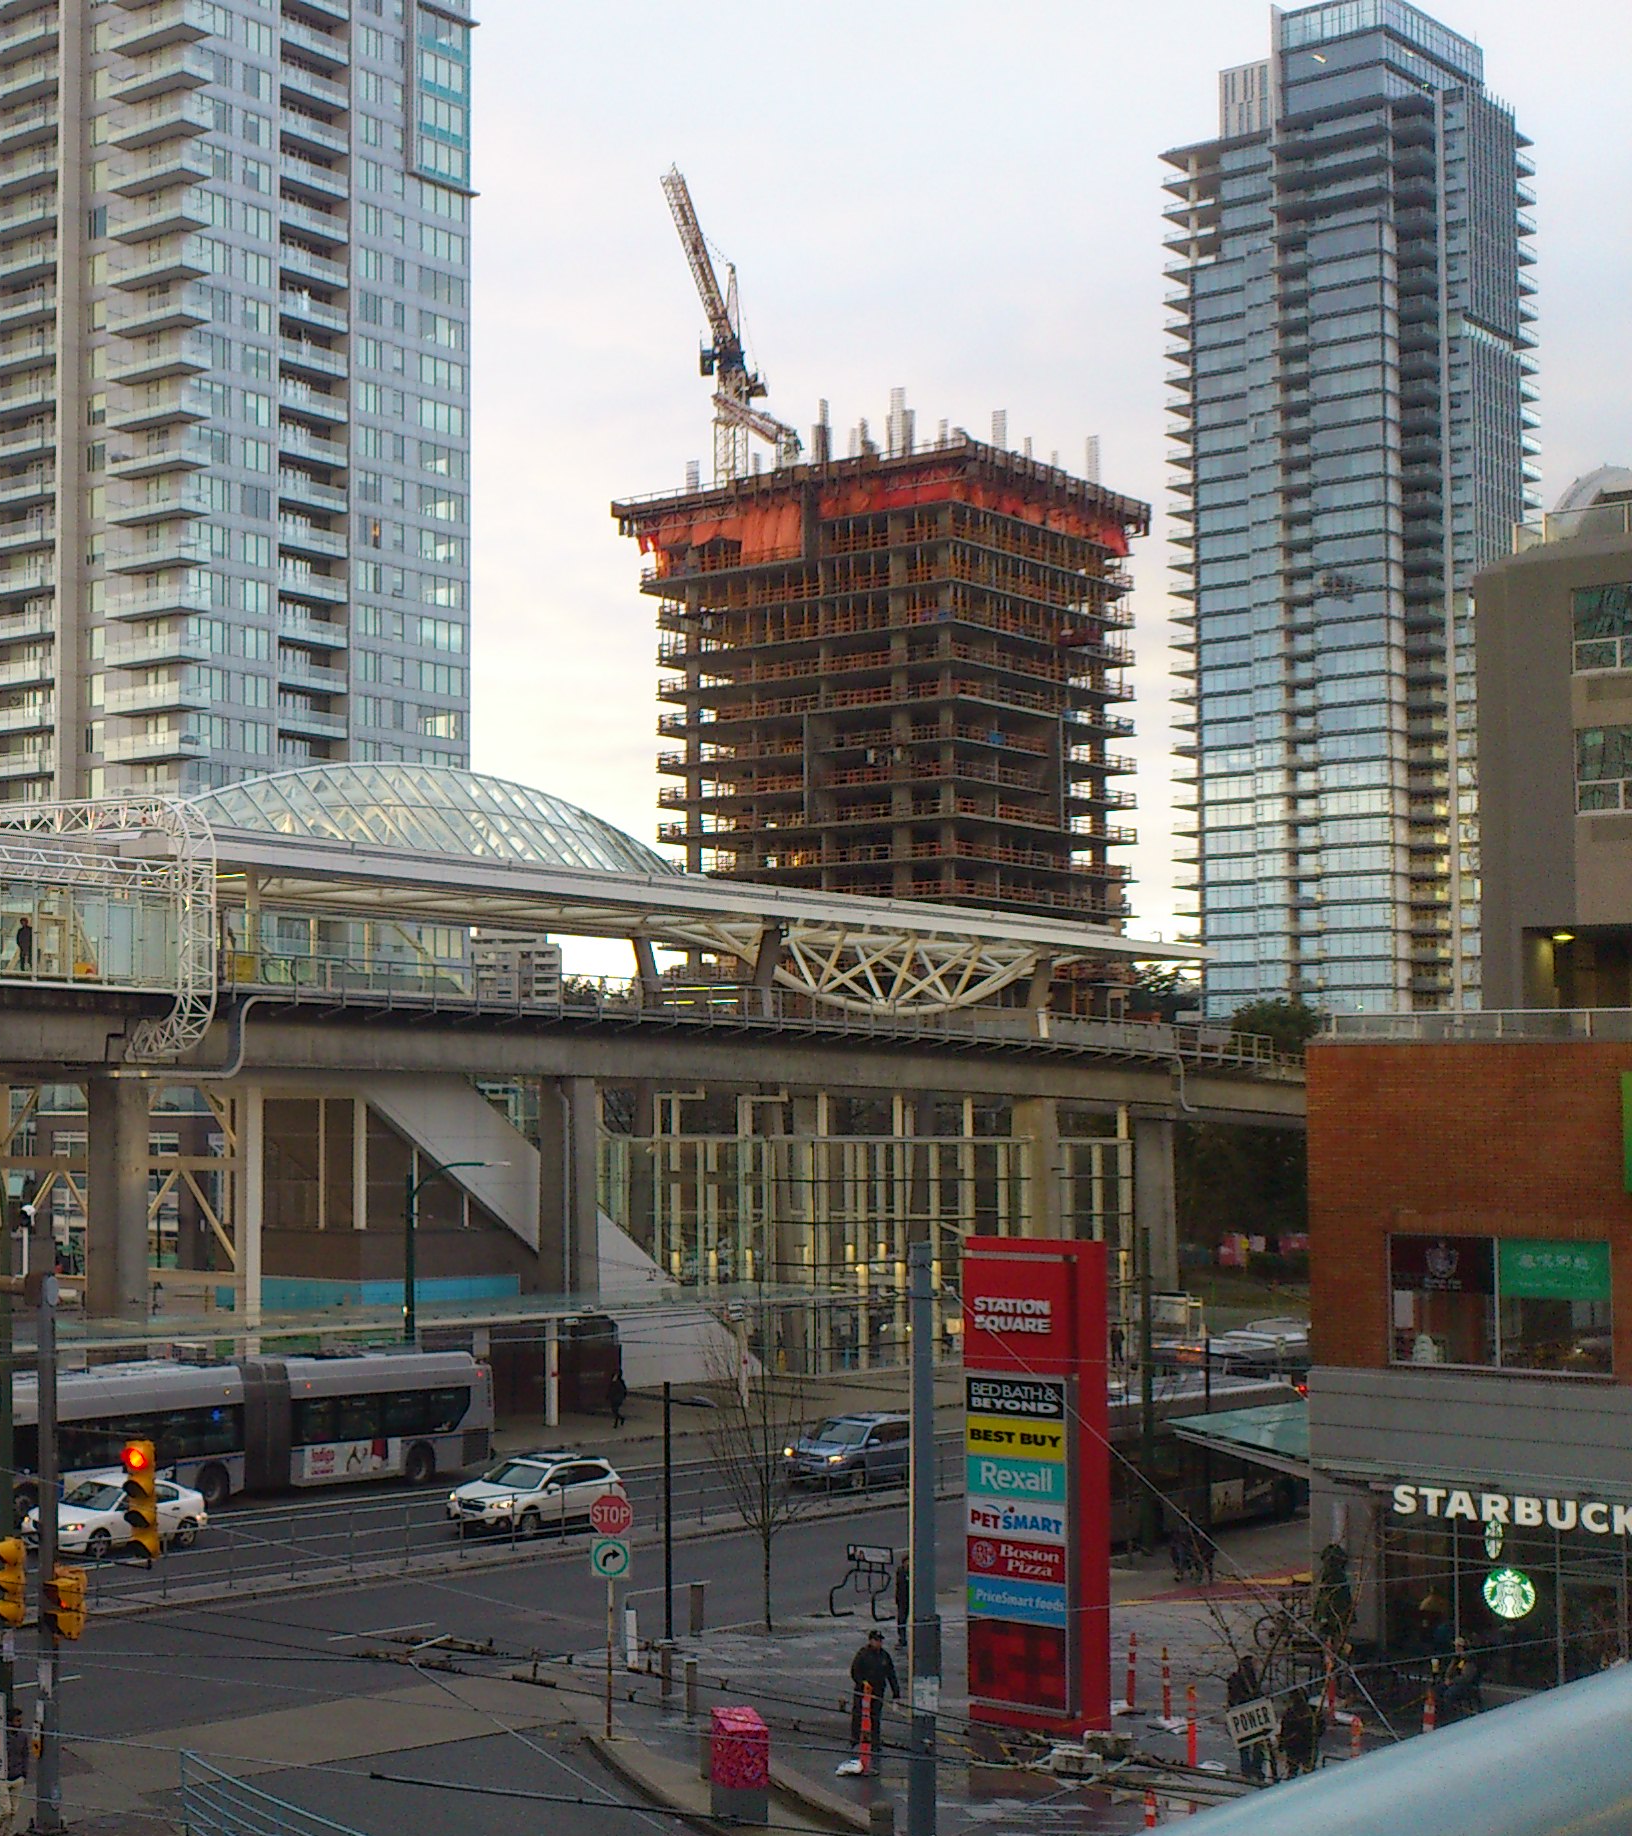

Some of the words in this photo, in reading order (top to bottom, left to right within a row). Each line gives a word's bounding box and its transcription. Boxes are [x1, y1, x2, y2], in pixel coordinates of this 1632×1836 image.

[974, 1296, 1051, 1315] STATION
[974, 1315, 1052, 1334] SQUARE
[971, 1383, 1000, 1397] BED
[1003, 1386, 1043, 1400] BATH
[1044, 1388, 1058, 1402] &
[971, 1397, 1059, 1414] BEYOND
[970, 1428, 1015, 1443] BEST
[1021, 1432, 1061, 1448] BUY
[980, 1461, 1053, 1493] Rexall
[592, 1505, 630, 1524] STOP
[999, 1544, 1060, 1564] Boston
[1007, 1559, 1052, 1577] Pizza
[975, 1588, 1034, 1608] PriceSmart
[1035, 1596, 1064, 1612] foods
[1232, 1706, 1271, 1734] POWER
